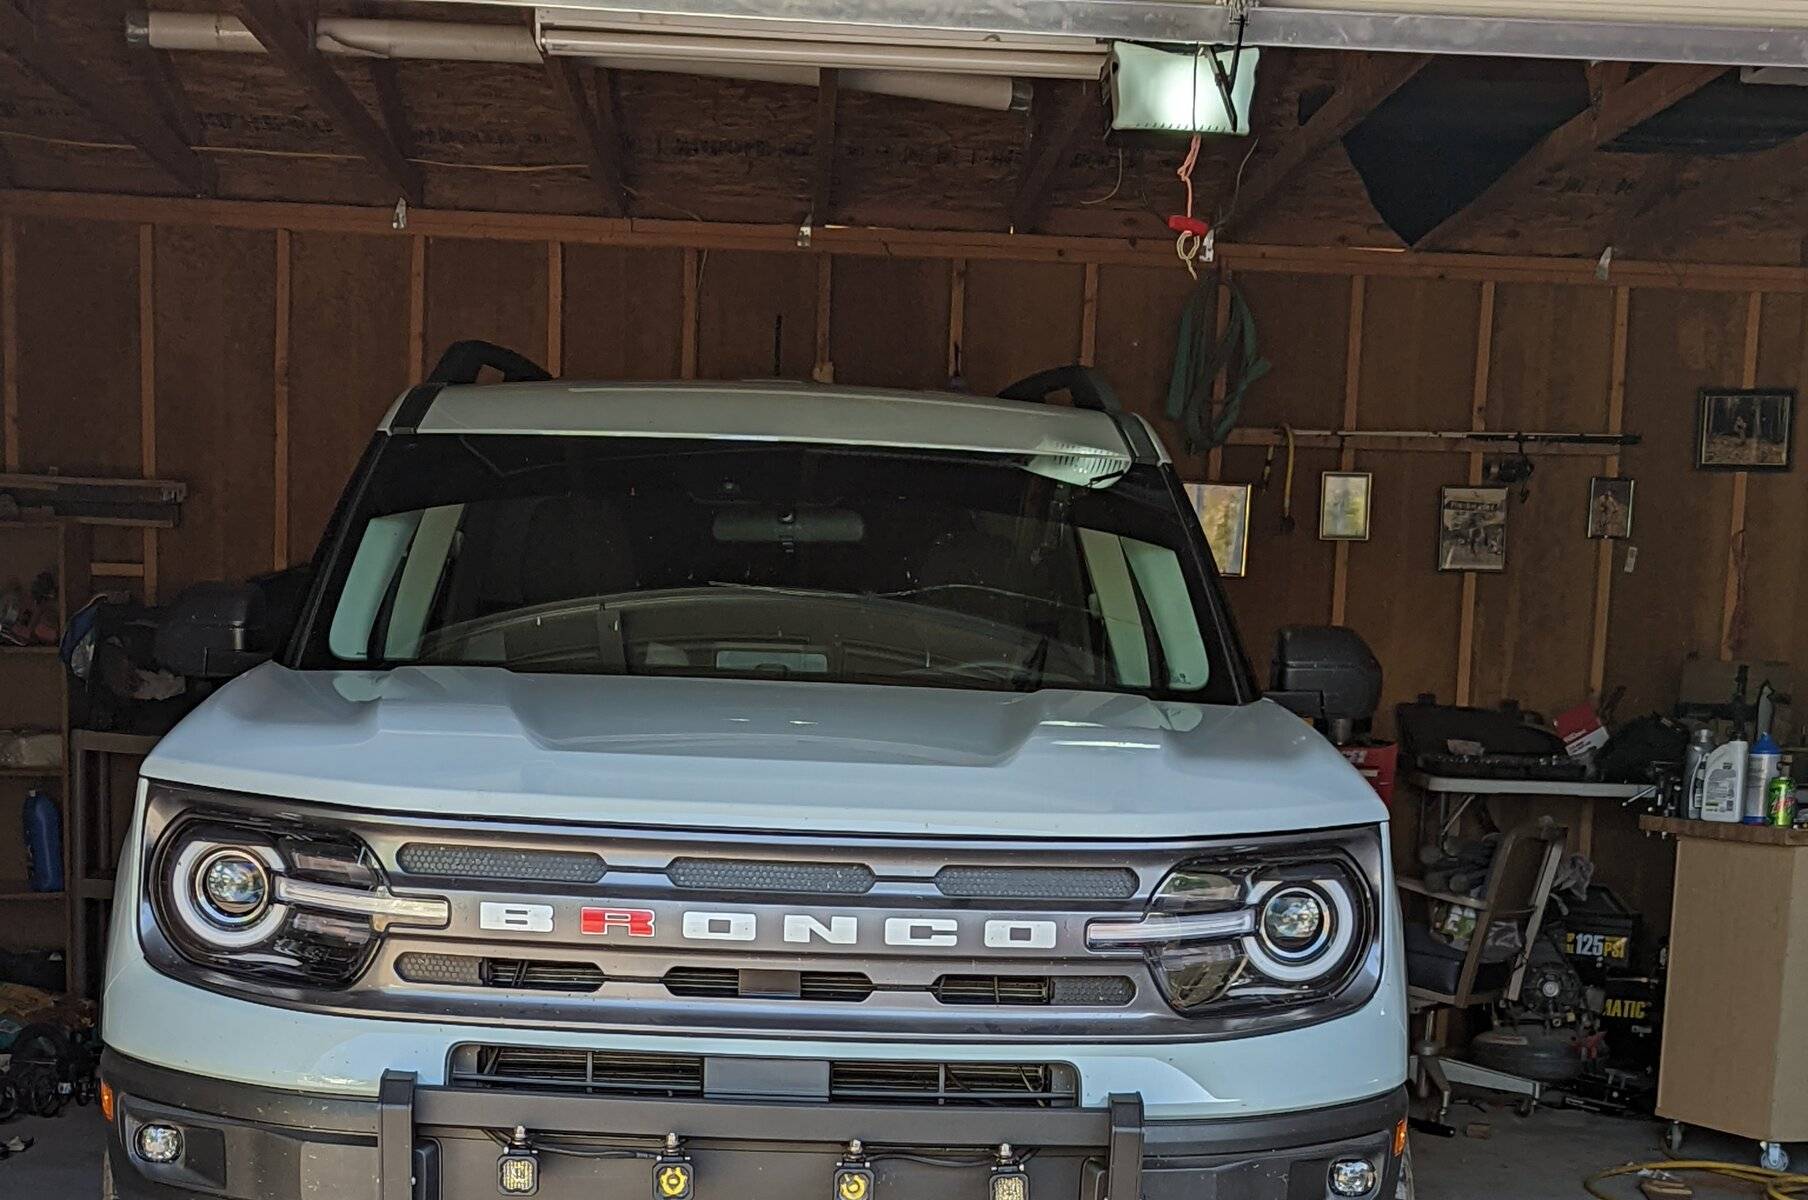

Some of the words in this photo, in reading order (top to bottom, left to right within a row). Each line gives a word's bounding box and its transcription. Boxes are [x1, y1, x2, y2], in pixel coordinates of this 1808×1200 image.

[479, 901, 1057, 949] BRONCO
[1575, 932, 1604, 956] 125
[1603, 940, 1627, 959] PSI
